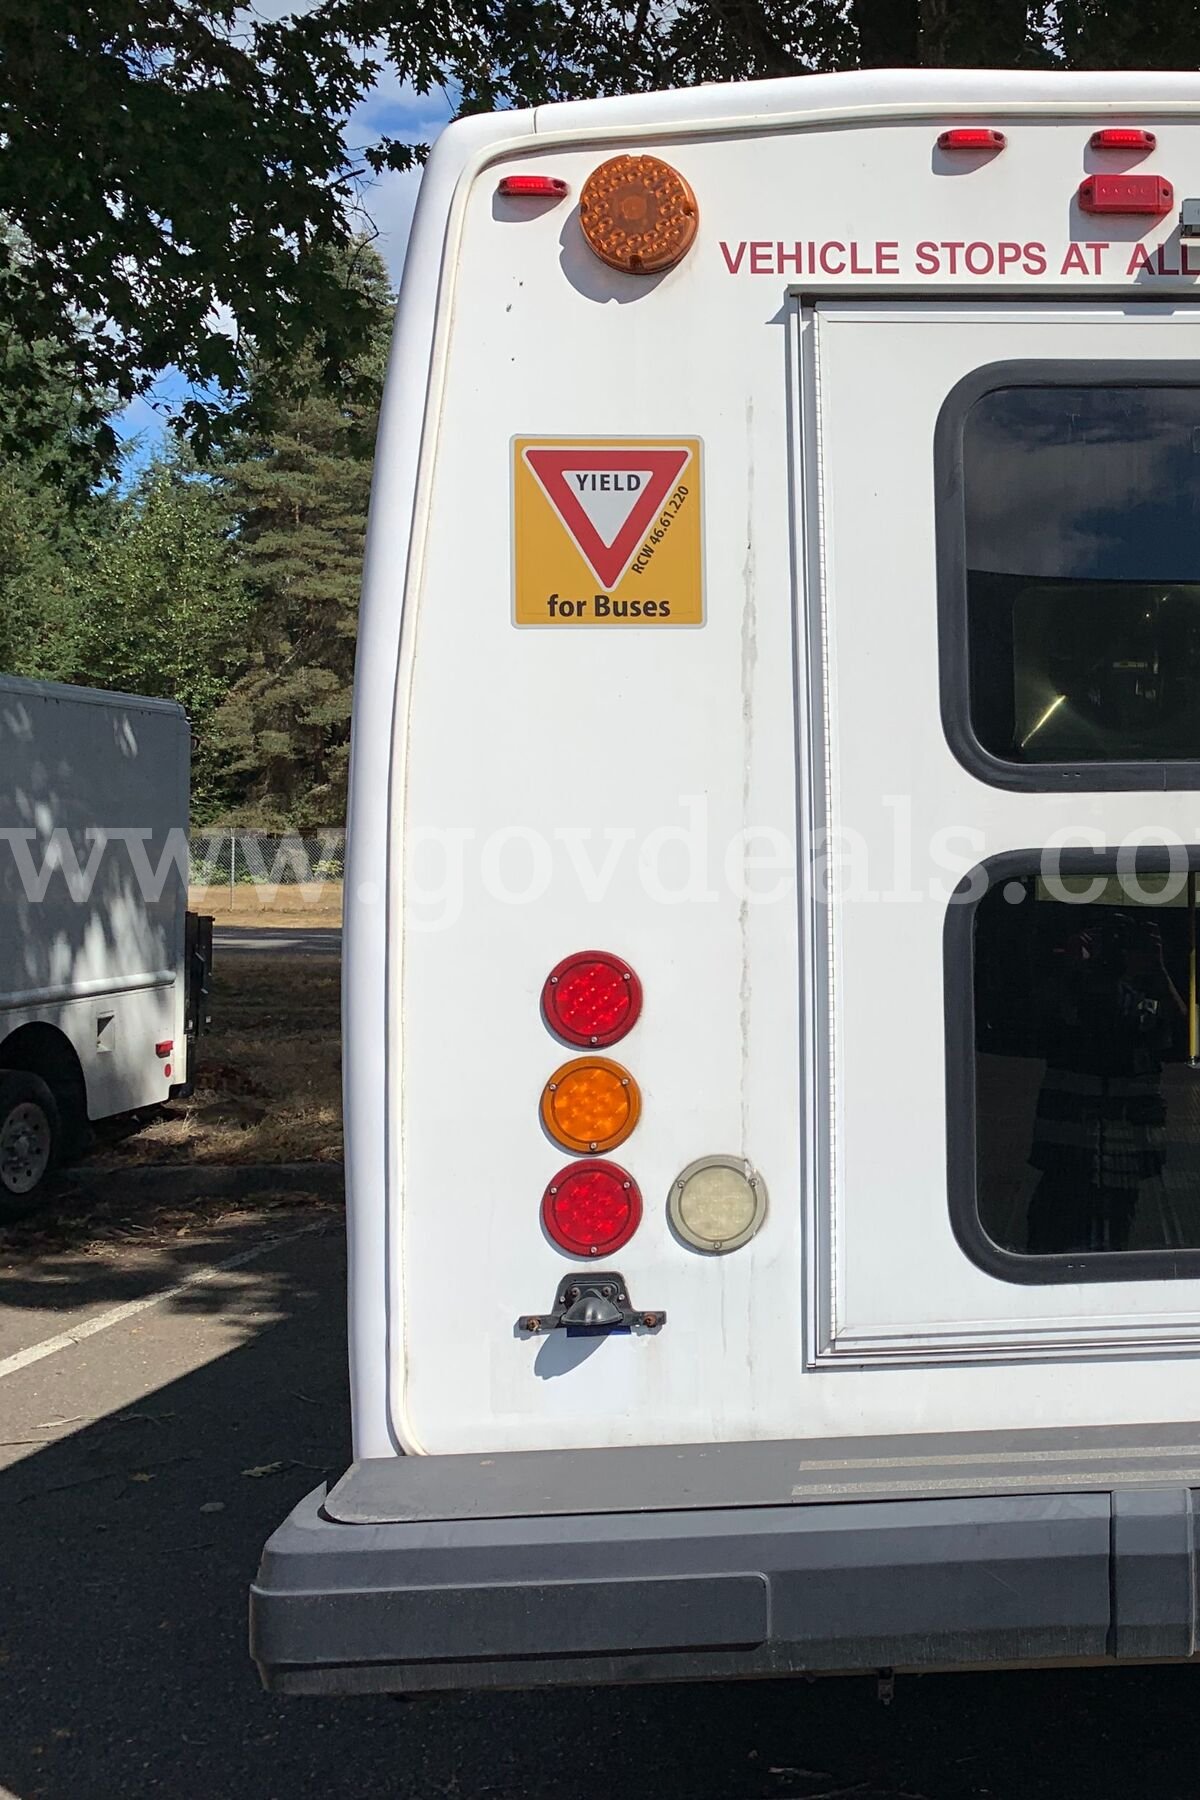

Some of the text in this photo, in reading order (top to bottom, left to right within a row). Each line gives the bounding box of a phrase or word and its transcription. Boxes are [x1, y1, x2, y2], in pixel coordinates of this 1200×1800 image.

[719, 241, 900, 275] VEHICLE
[915, 241, 1047, 275] STOPS
[1060, 242, 1109, 275] AT
[575, 474, 641, 491] YIELD
[631, 485, 689, 574] RCW 46.61.220
[547, 594, 671, 618] for Buses
